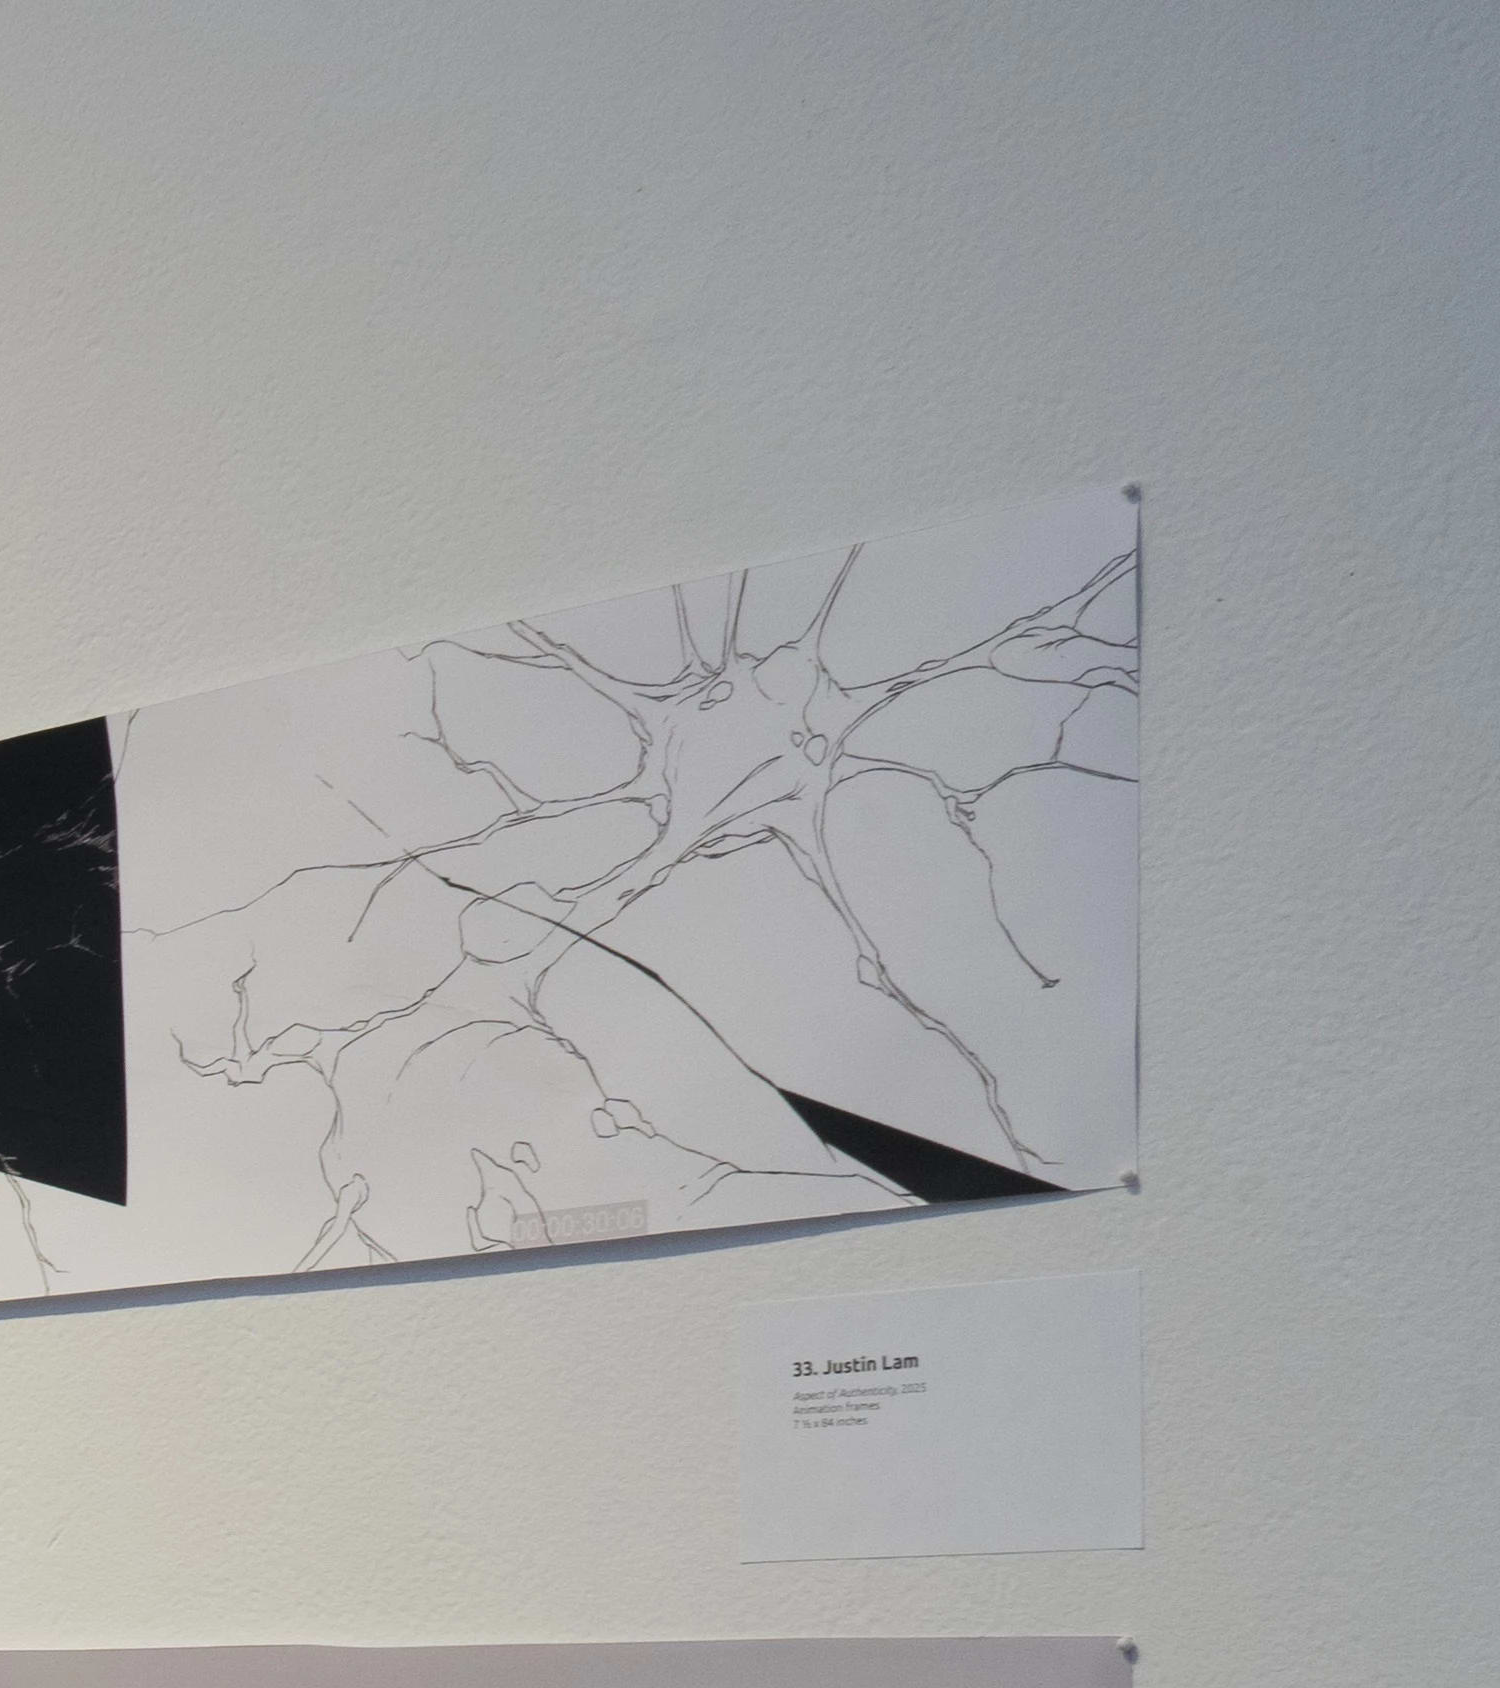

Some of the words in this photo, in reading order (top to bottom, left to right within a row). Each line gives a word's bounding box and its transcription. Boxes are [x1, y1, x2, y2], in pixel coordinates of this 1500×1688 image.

[792, 1361, 818, 1378] 33.
[822, 1355, 877, 1376] Justin
[882, 1354, 920, 1371] Lam
